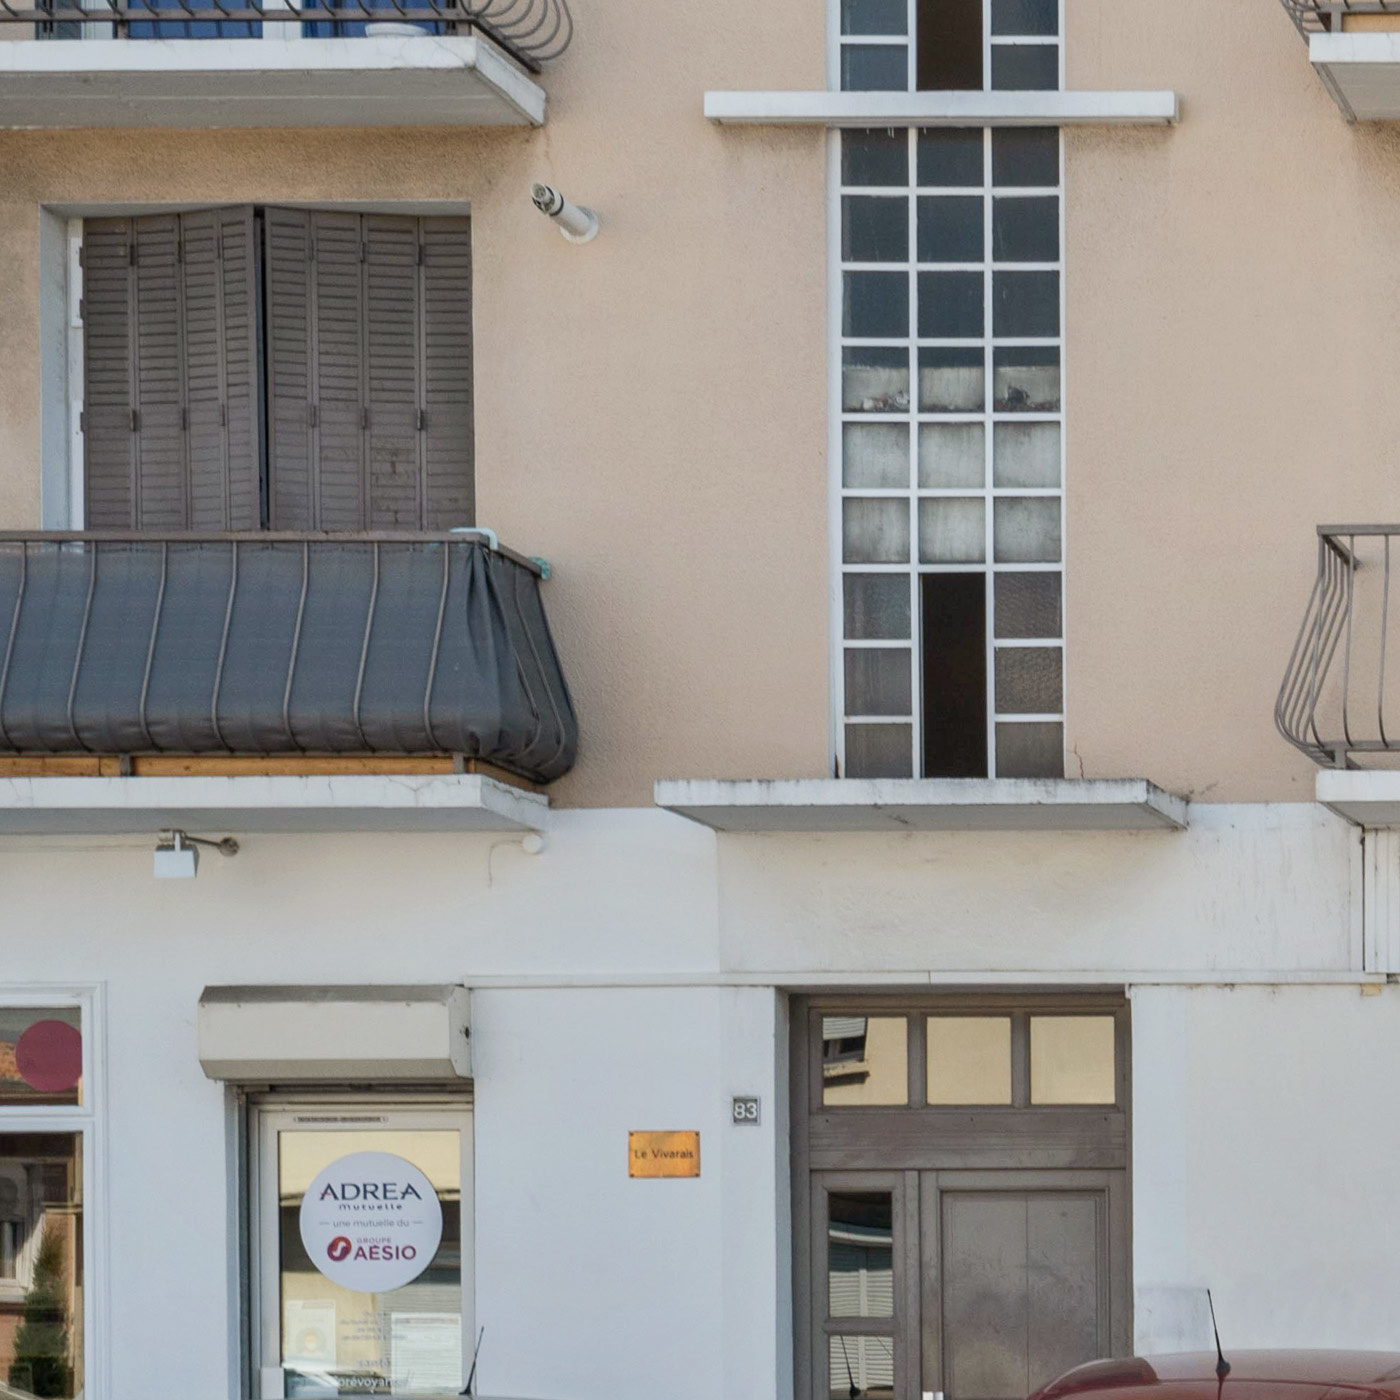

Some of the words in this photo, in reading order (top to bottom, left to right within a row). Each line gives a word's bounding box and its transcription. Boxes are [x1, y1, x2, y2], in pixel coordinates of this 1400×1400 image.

[733, 1102, 758, 1119] 83
[634, 1149, 648, 1159] Le
[652, 1149, 694, 1159] Vivarais
[319, 1182, 422, 1201] ADREA
[339, 1203, 403, 1211] mutuelle
[333, 1219, 351, 1228] une
[353, 1218, 394, 1228] mutuelle
[396, 1218, 410, 1228] du
